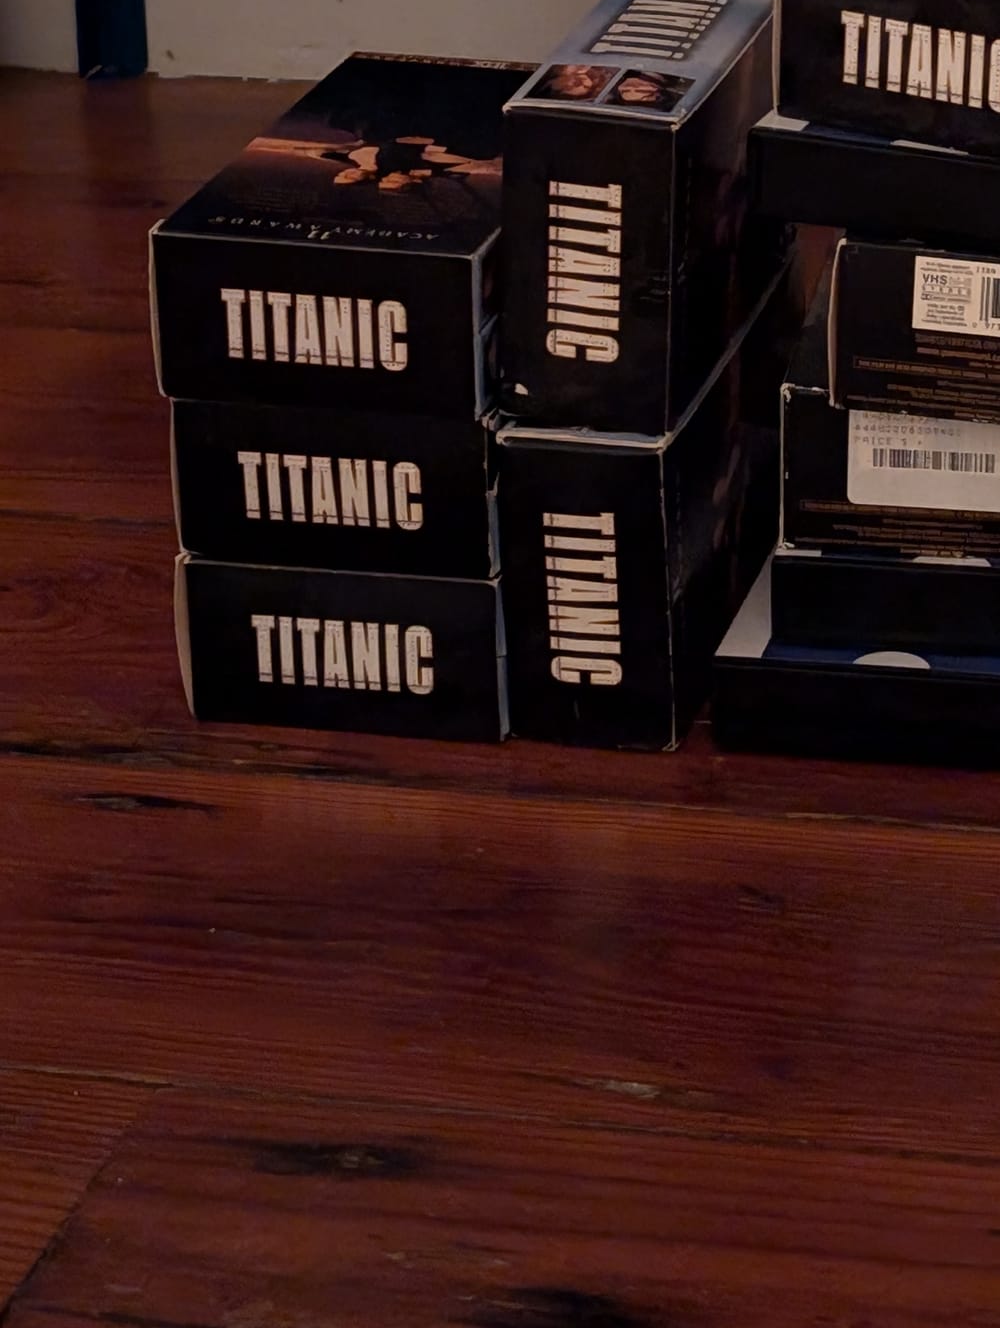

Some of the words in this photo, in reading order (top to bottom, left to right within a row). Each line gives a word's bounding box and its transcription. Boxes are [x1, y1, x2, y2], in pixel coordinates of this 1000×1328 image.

[547, 181, 622, 363] TITANIC
[922, 273, 949, 286] VHS
[220, 288, 408, 372] TITANIC
[237, 451, 423, 530] TITANIC
[543, 513, 623, 686] TITANIC
[251, 614, 434, 695] TITANIC
